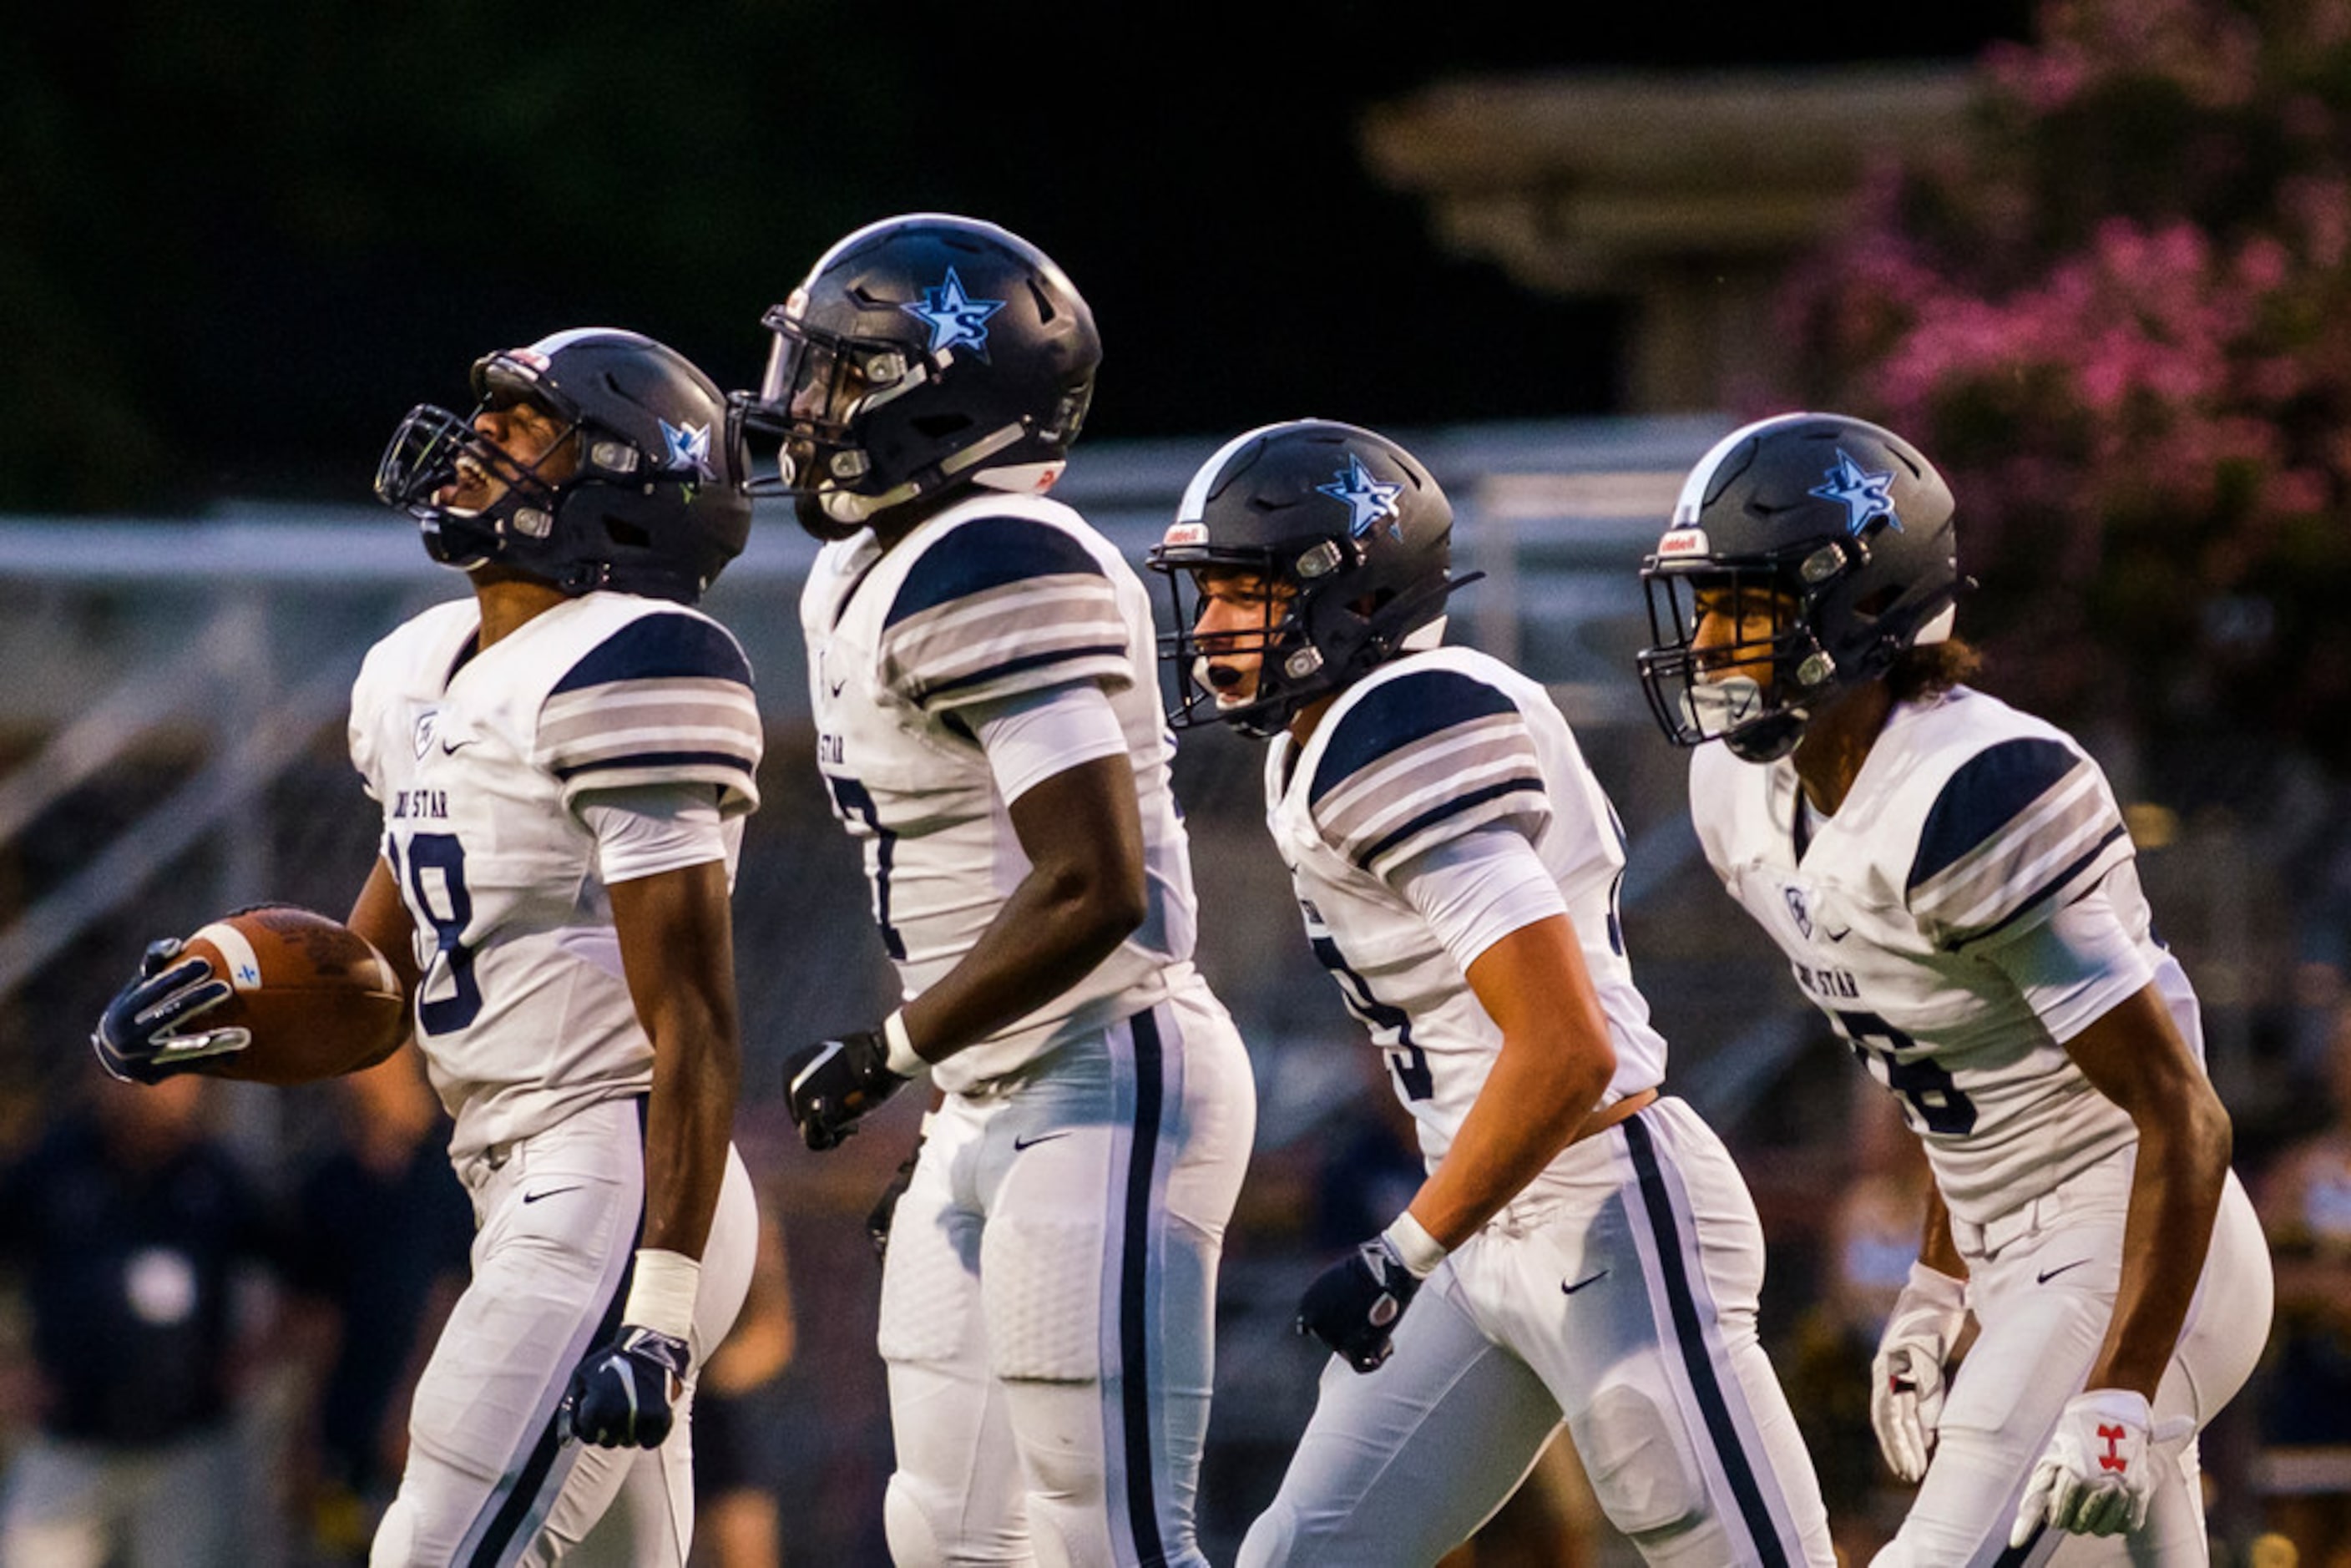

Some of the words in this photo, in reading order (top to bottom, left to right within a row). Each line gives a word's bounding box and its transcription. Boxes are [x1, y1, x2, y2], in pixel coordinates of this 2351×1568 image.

[412, 790, 448, 818] STAR
[388, 832, 483, 1036] 8
[1817, 970, 1860, 998] STAR
